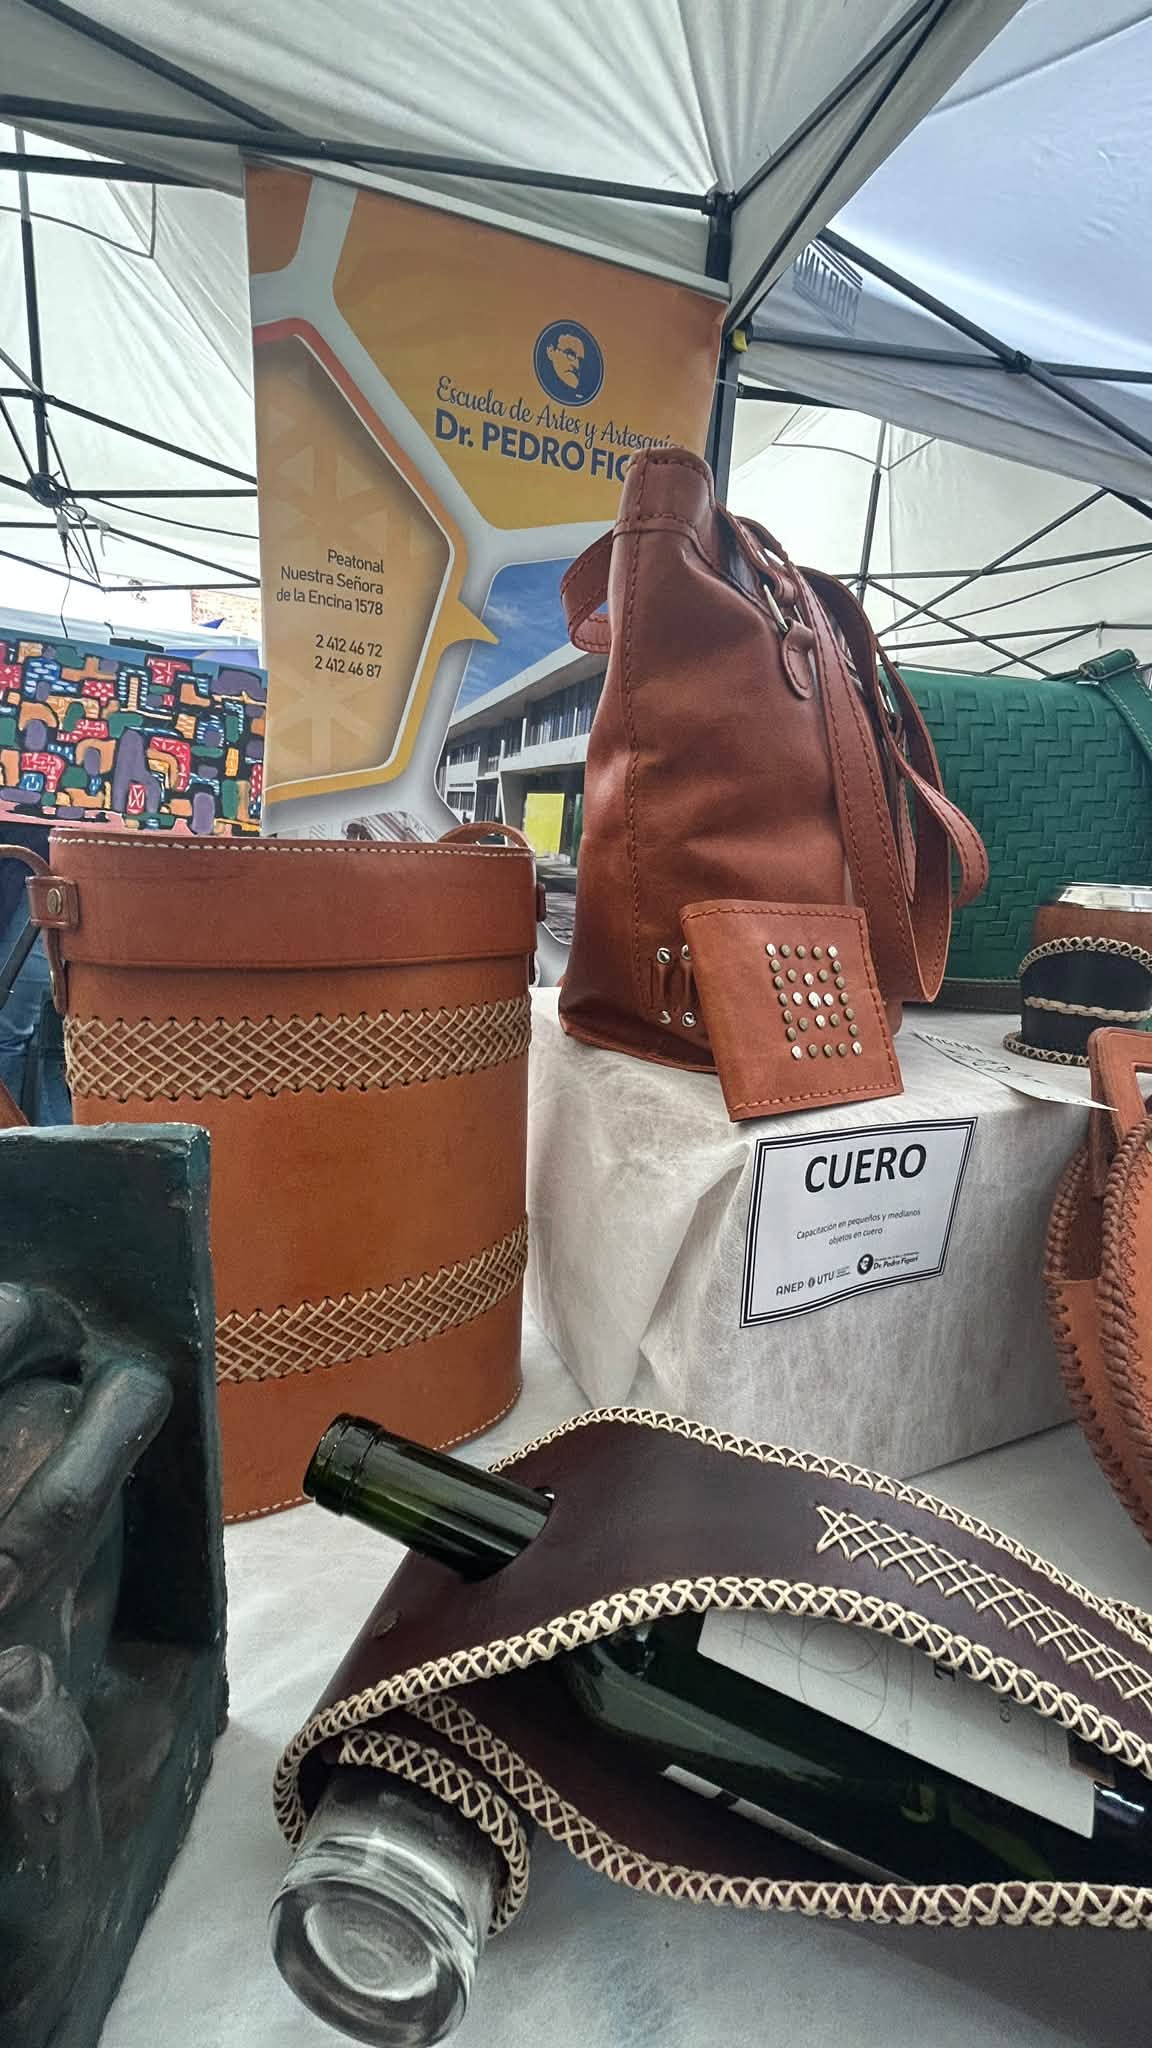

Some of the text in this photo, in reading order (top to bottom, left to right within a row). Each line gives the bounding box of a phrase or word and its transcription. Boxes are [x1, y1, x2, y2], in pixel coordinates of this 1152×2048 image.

[436, 375, 507, 417] Escuela
[509, 397, 533, 423] de
[536, 404, 581, 434] Artes
[584, 421, 598, 450] y
[435, 408, 474, 448] Dr.
[482, 421, 585, 472] PEDRO
[327, 548, 385, 574] Peatonal
[280, 565, 384, 595] Nuestra Señora
[276, 588, 383, 616] de la Encina 1578
[315, 633, 383, 658] 2 412 46 72
[314, 655, 382, 679] 2 412 46 87
[804, 1143, 927, 1193] CUERO
[837, 1220, 847, 1228] en
[881, 1213, 887, 1222] y
[887, 1208, 921, 1220] medianos
[828, 1227, 884, 1246] objetos en cuero
[775, 1280, 805, 1296] ANEP
[817, 1270, 836, 1286] UTU
